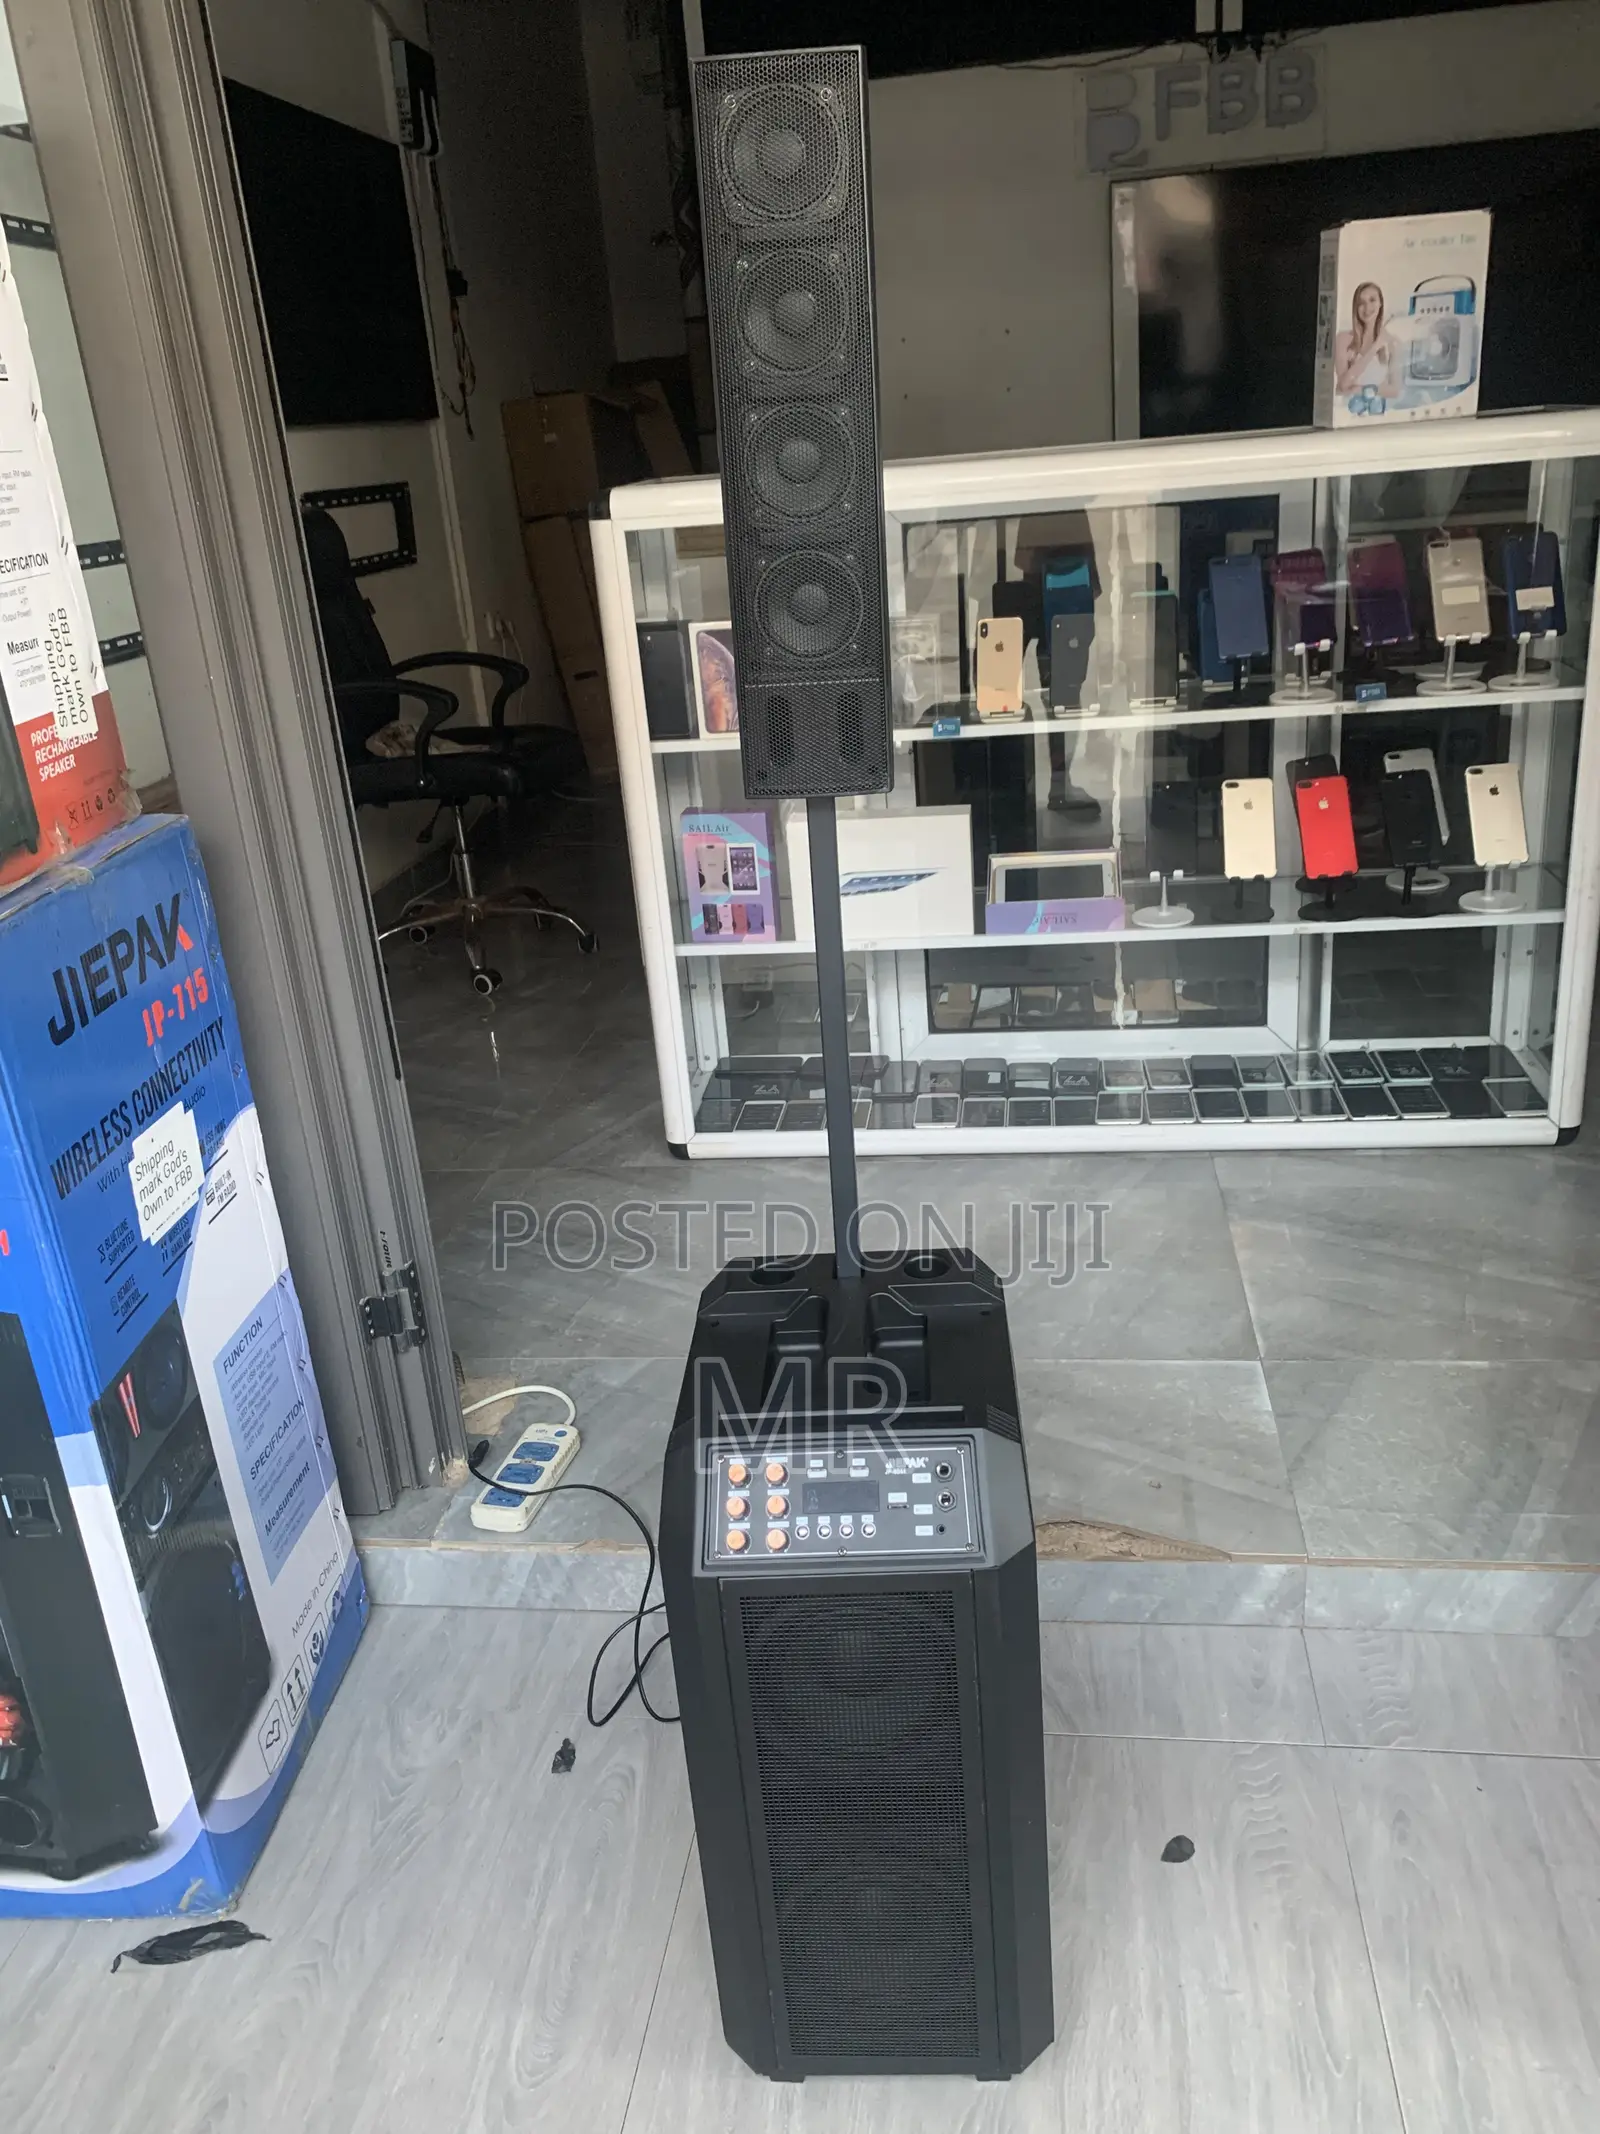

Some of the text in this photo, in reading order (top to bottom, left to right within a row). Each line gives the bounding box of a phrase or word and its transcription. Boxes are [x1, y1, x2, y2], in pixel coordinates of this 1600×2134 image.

[1155, 49, 1318, 142] FBB
[44, 639, 68, 727] Shipping
[48, 612, 79, 726] mark God's
[57, 607, 89, 723] Own to FBB
[39, 754, 77, 782] SPEAKER
[48, 892, 194, 1046] JIEPAK
[50, 1015, 226, 1201] WIRELESS CONNECTIVITY
[97, 1166, 121, 1193] With
[182, 1085, 206, 1114] Audio
[134, 1139, 175, 1183] Shipping
[139, 1148, 189, 1203] mark God's
[143, 1164, 193, 1222] Own to FBB
[223, 1316, 263, 1376] FUNCTION
[250, 1396, 305, 1481] SPECIFICATION
[265, 1461, 310, 1537] Measurement
[291, 1551, 339, 1639] Made in China
